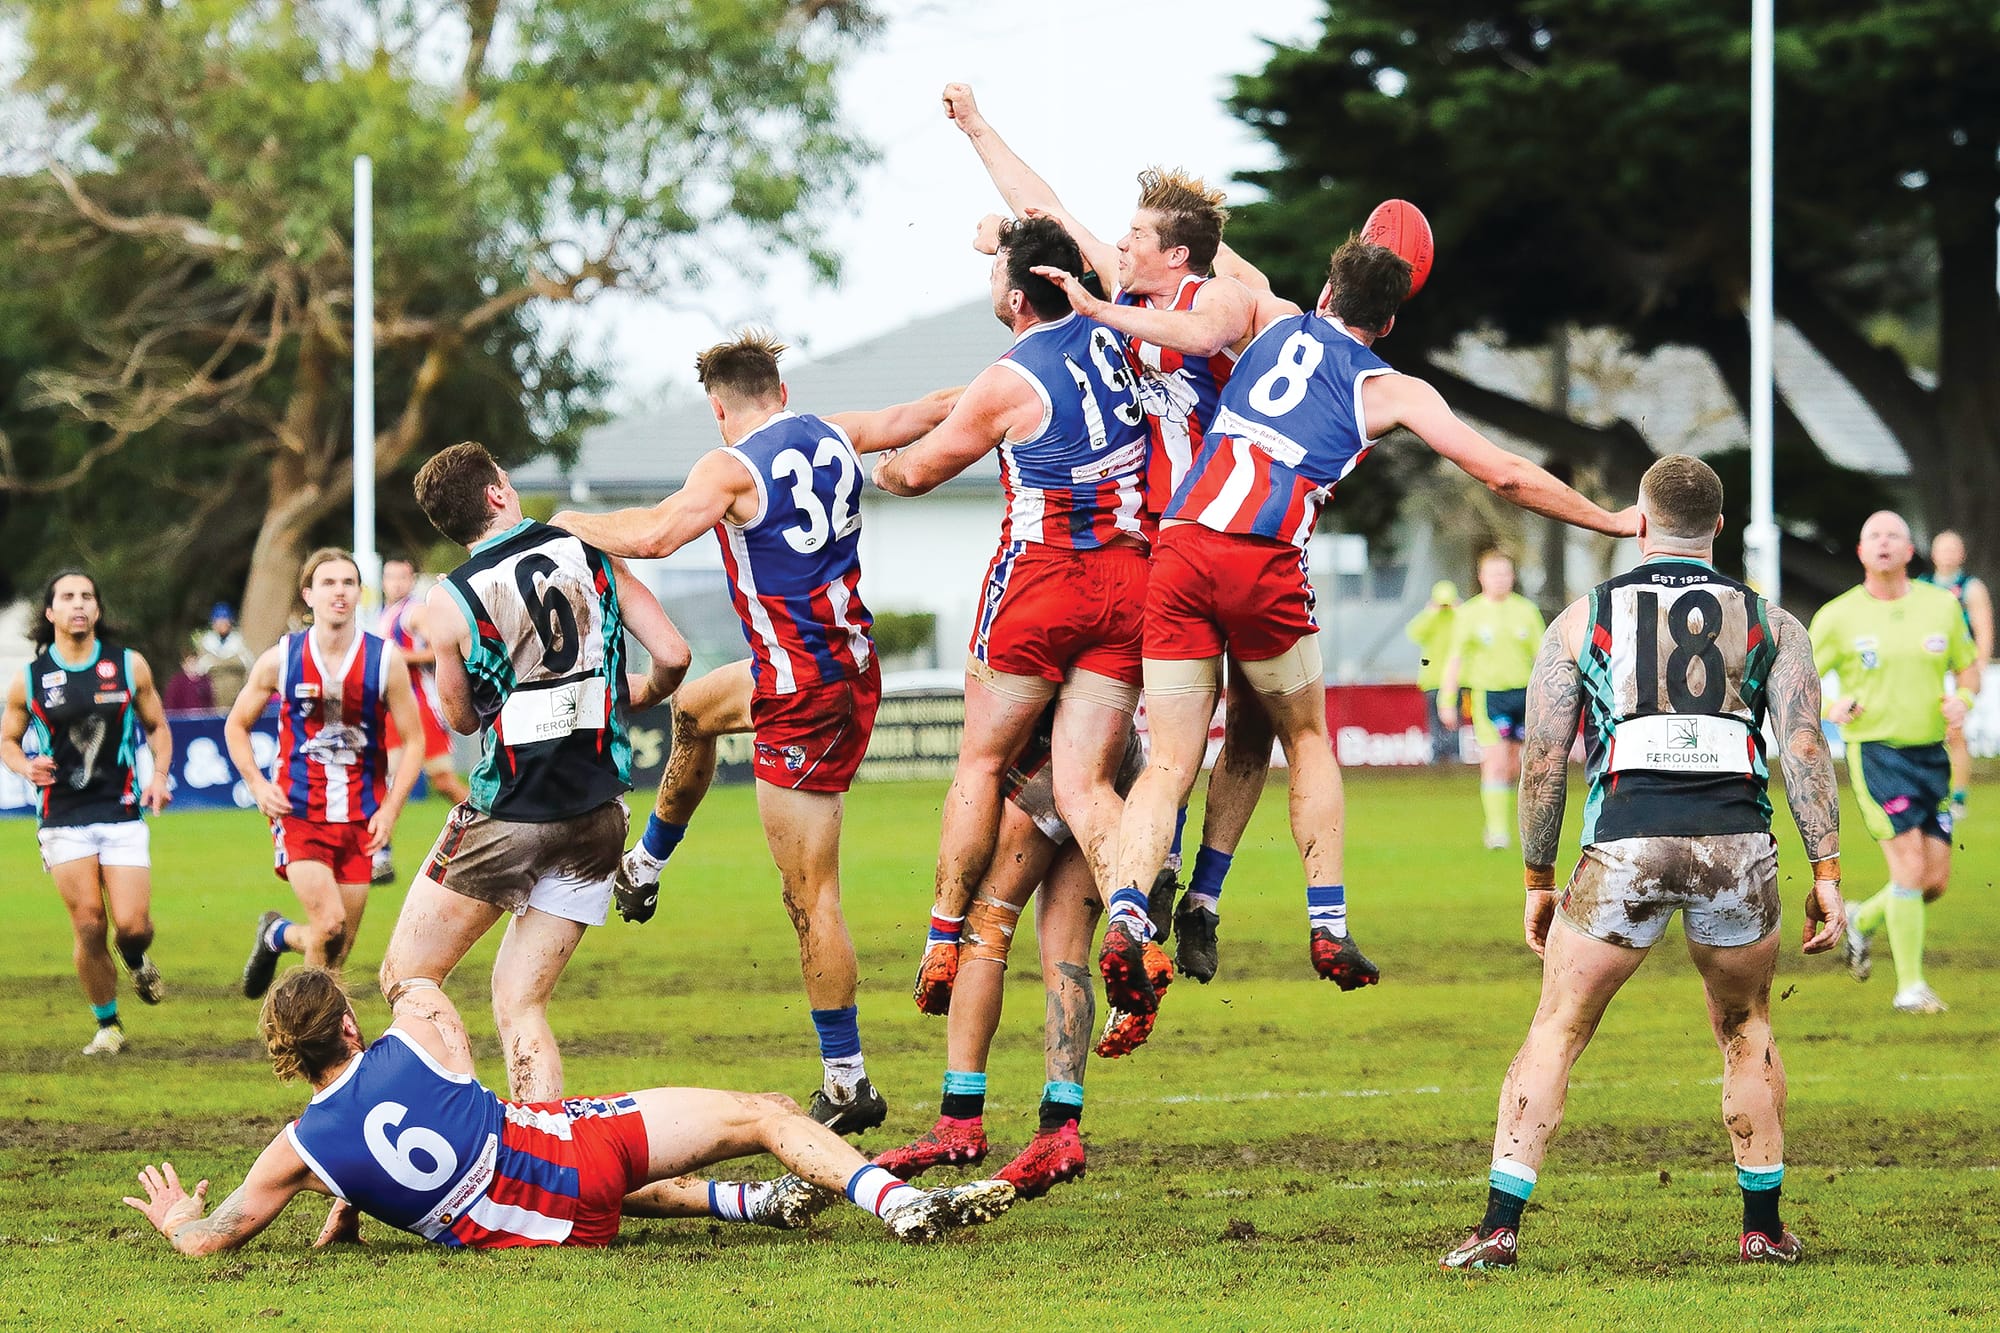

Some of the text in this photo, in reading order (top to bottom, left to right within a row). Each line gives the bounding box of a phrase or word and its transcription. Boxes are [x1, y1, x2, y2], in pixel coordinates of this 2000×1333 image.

[1063, 326, 1143, 451] 19
[1248, 330, 1325, 418] 8
[771, 437, 862, 554] 32
[515, 553, 579, 673] 6
[1651, 574, 1676, 585] EST
[1637, 589, 1725, 714] 18
[1646, 753, 1718, 763] FERGUSON
[364, 1101, 457, 1191] 6
